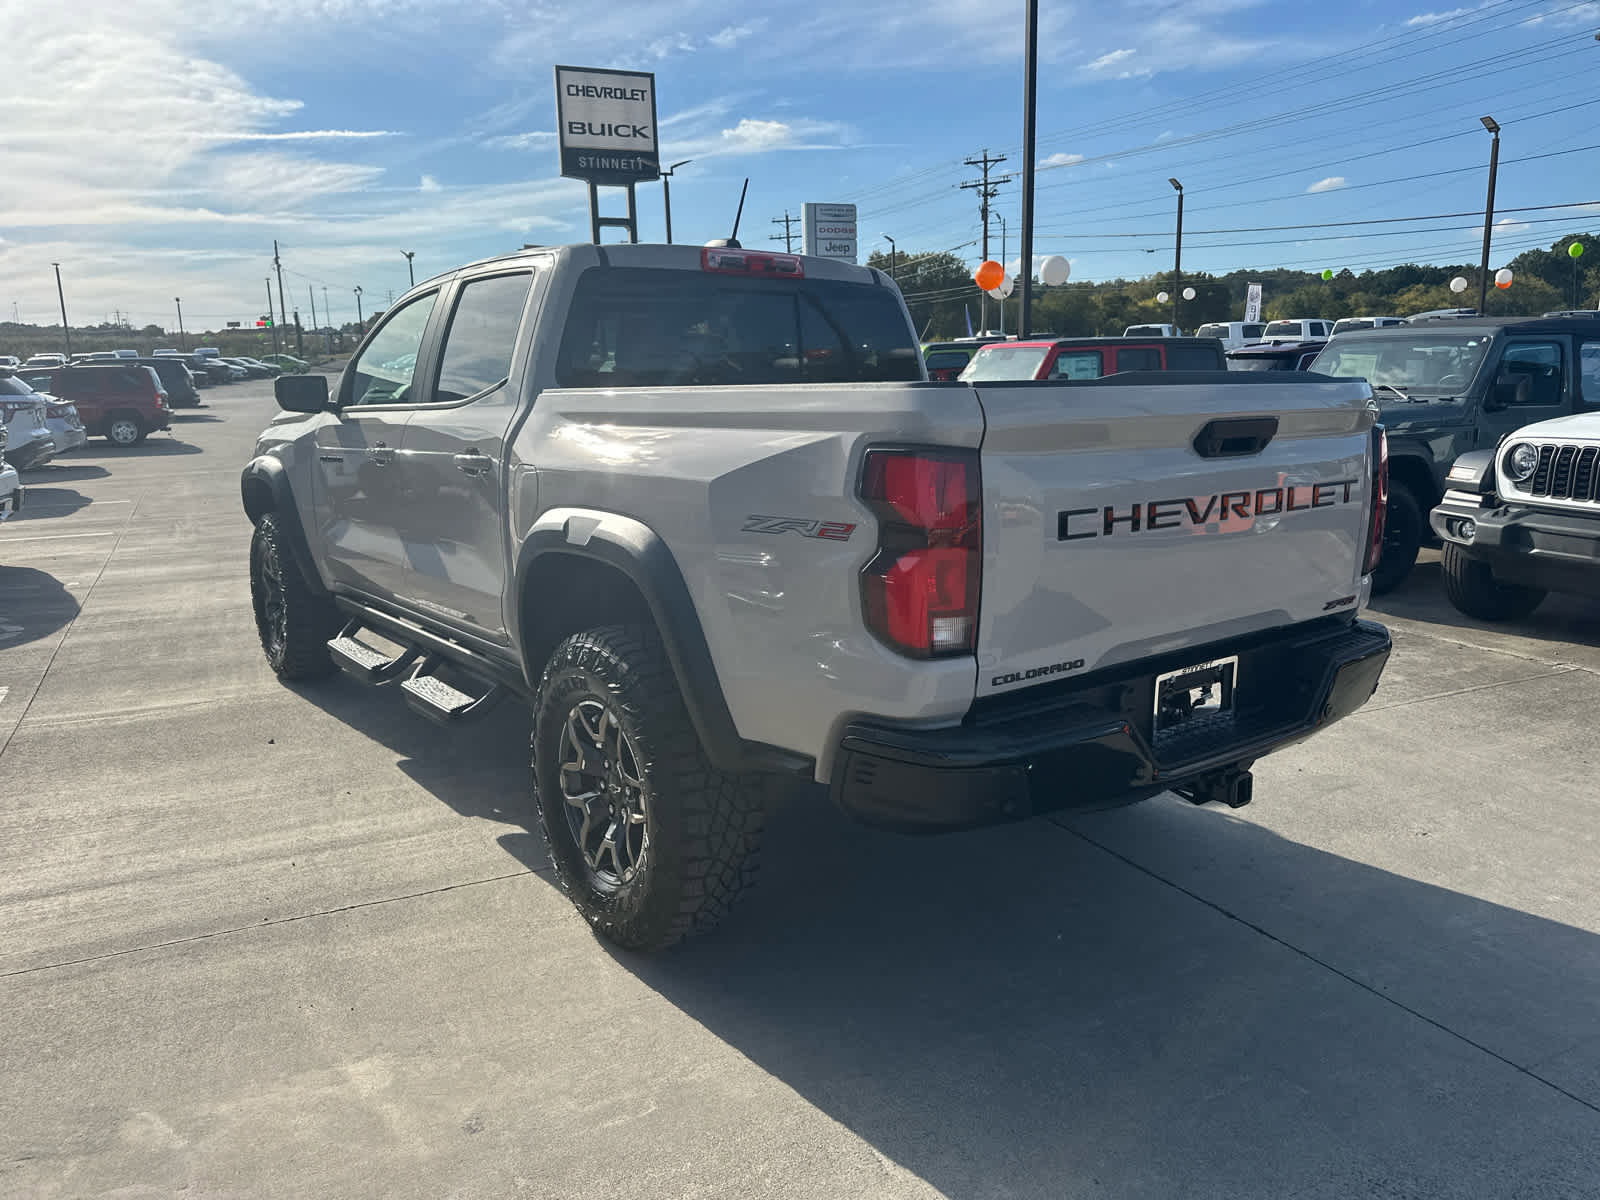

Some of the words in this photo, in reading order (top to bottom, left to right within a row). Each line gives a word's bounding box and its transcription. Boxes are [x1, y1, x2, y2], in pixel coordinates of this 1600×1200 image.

[566, 84, 648, 102] CHEVROLET
[568, 121, 651, 139] BUICK
[825, 241, 850, 254] Jeep
[1057, 479, 1359, 541] CHEVROLET
[740, 514, 857, 541] ZR2
[991, 658, 1085, 686] COLORADO
